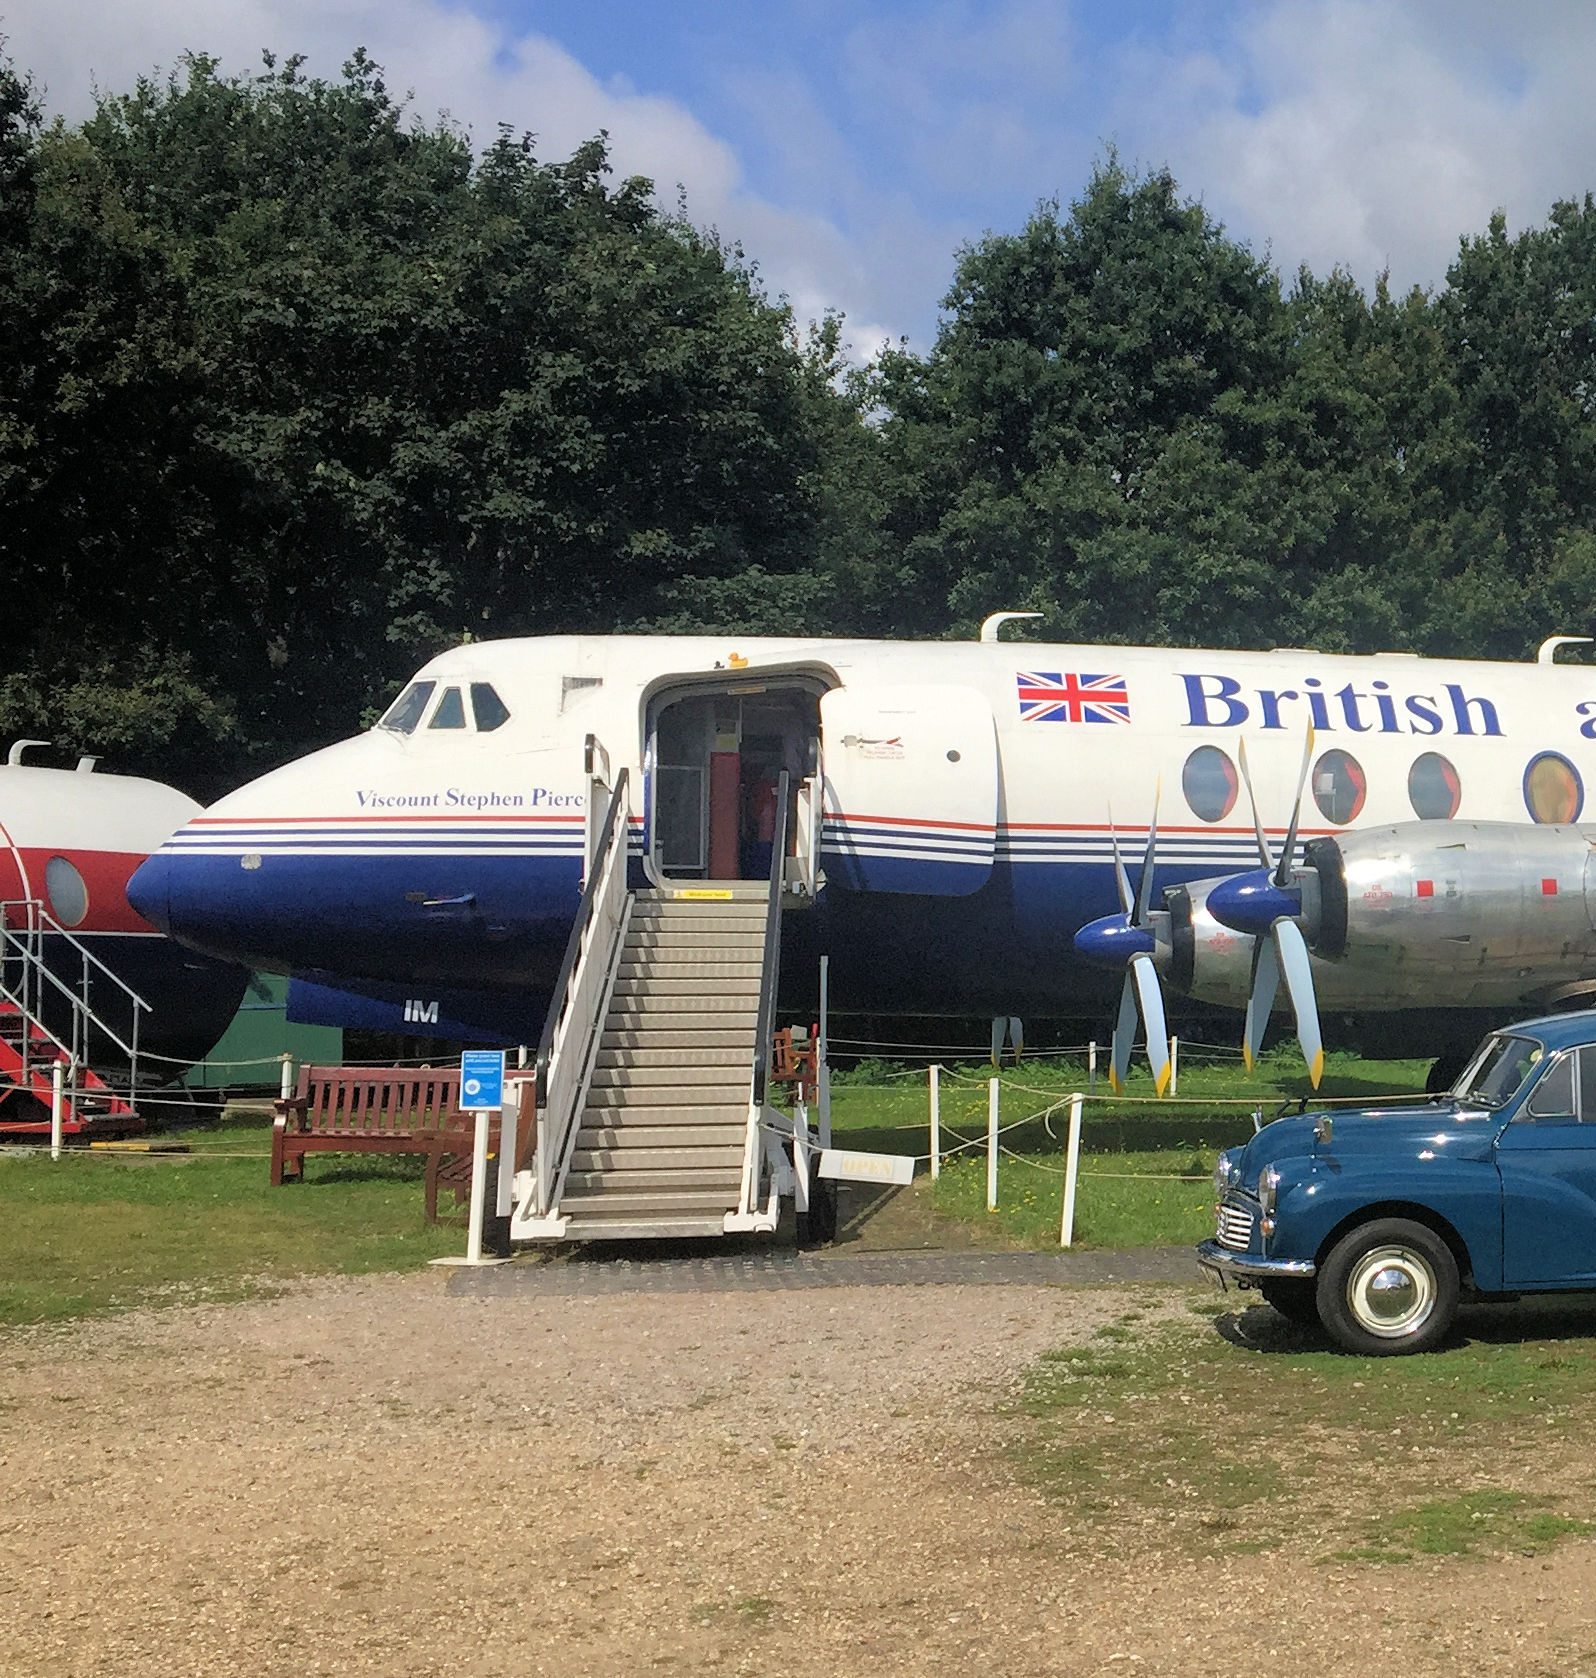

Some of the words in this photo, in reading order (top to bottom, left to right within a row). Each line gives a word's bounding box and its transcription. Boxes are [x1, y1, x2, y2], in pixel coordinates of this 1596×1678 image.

[1172, 672, 1507, 737] British
[356, 790, 439, 807] Viscount
[445, 788, 523, 810] Stephen
[531, 788, 587, 807] Pierc
[404, 1000, 439, 1023] IM
